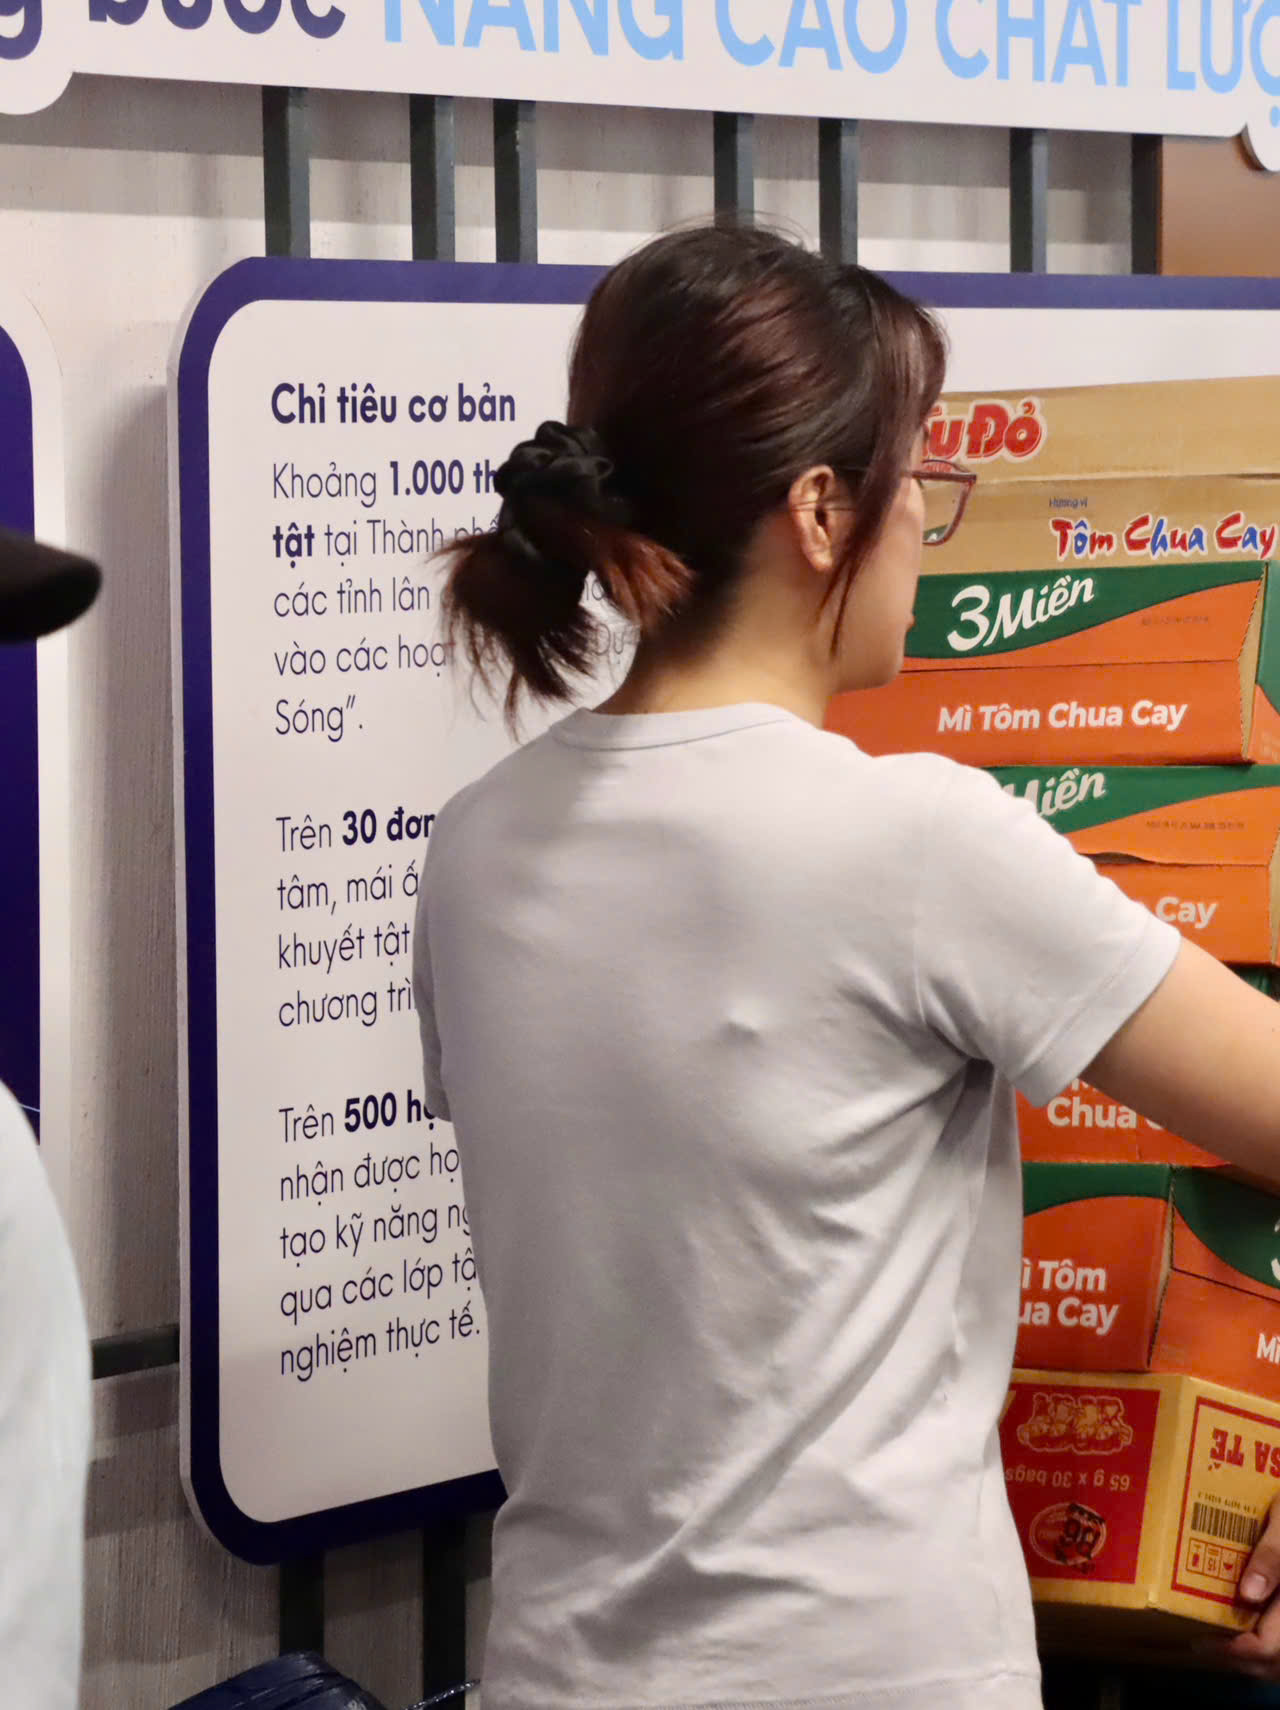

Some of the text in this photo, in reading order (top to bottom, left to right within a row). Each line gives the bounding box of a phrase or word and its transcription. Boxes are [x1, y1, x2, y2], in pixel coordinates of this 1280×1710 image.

[715, 0, 908, 75] CAO
[271, 382, 516, 424] Chỉ tiêu cơ bản
[272, 462, 377, 508] Khoảng
[389, 459, 465, 497] 1.000
[272, 521, 315, 569] tật
[324, 519, 358, 567] tại
[366, 517, 445, 556] Thành
[1050, 511, 1277, 559] Tôm Chua Cay
[273, 576, 430, 617] các tỉnh lân
[274, 640, 327, 676] vào
[335, 637, 389, 673] các
[937, 698, 1189, 733] Mì Tôm Chua Cay
[276, 814, 332, 852] Trên
[342, 808, 377, 846] 30
[277, 874, 337, 916] tâm,
[347, 864, 393, 904] mái
[1155, 896, 1218, 930] Cay
[278, 921, 411, 975] khuyết tật
[278, 990, 378, 1028] chương
[278, 1104, 334, 1143] Trên
[344, 1092, 398, 1133] 500
[1046, 1095, 1138, 1130] Chua
[280, 1160, 344, 1206] nhận
[354, 1152, 421, 1193] được
[280, 1227, 326, 1268] tạo
[336, 1212, 364, 1258] kỹ
[374, 1203, 438, 1244] năng
[280, 1284, 332, 1326] qua
[342, 1266, 394, 1305] các
[403, 1257, 443, 1300] lớp
[1037, 1258, 1107, 1292] Tôm
[1056, 1296, 1120, 1337] Cay
[281, 1300, 481, 1383] nghiệm thực tế.
[1207, 1427, 1245, 1472] TẾ
[1005, 1464, 1131, 1492] 65 g x 30 bags
